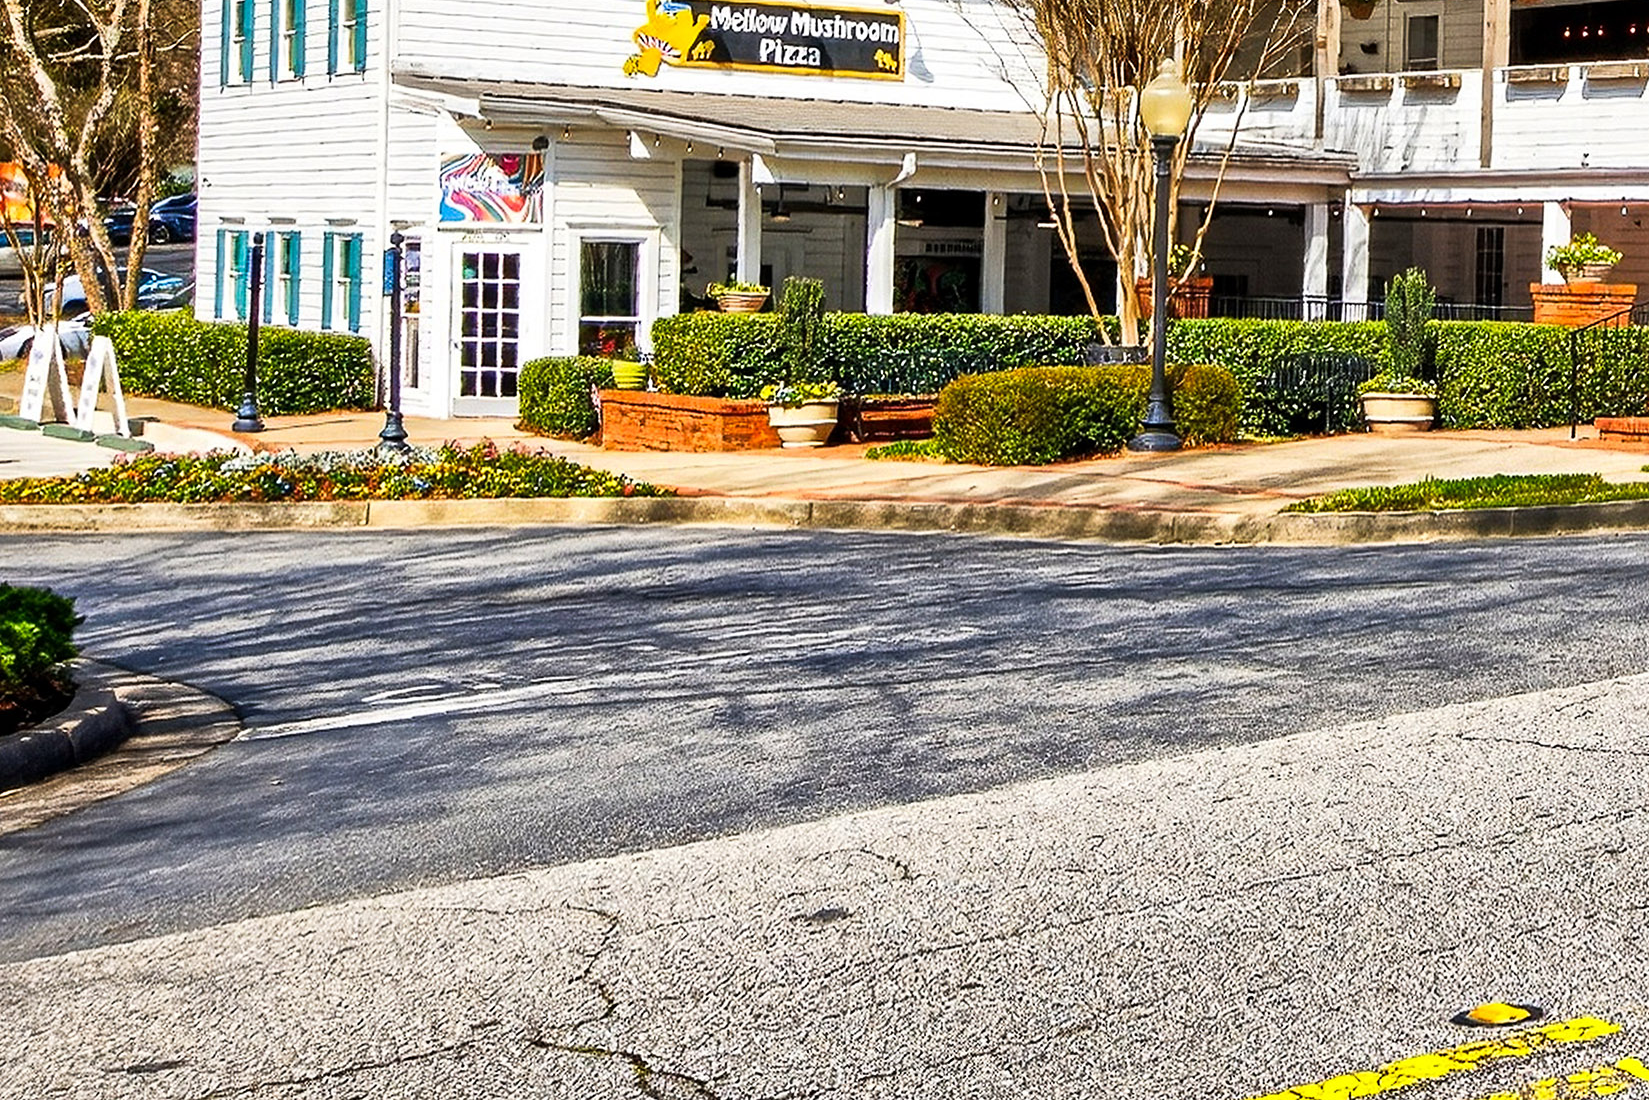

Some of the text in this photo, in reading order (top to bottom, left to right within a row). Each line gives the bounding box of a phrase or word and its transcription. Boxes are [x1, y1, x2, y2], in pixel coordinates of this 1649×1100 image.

[711, 5, 900, 44] Mellow Mushroom
[760, 38, 821, 67] Pizza
